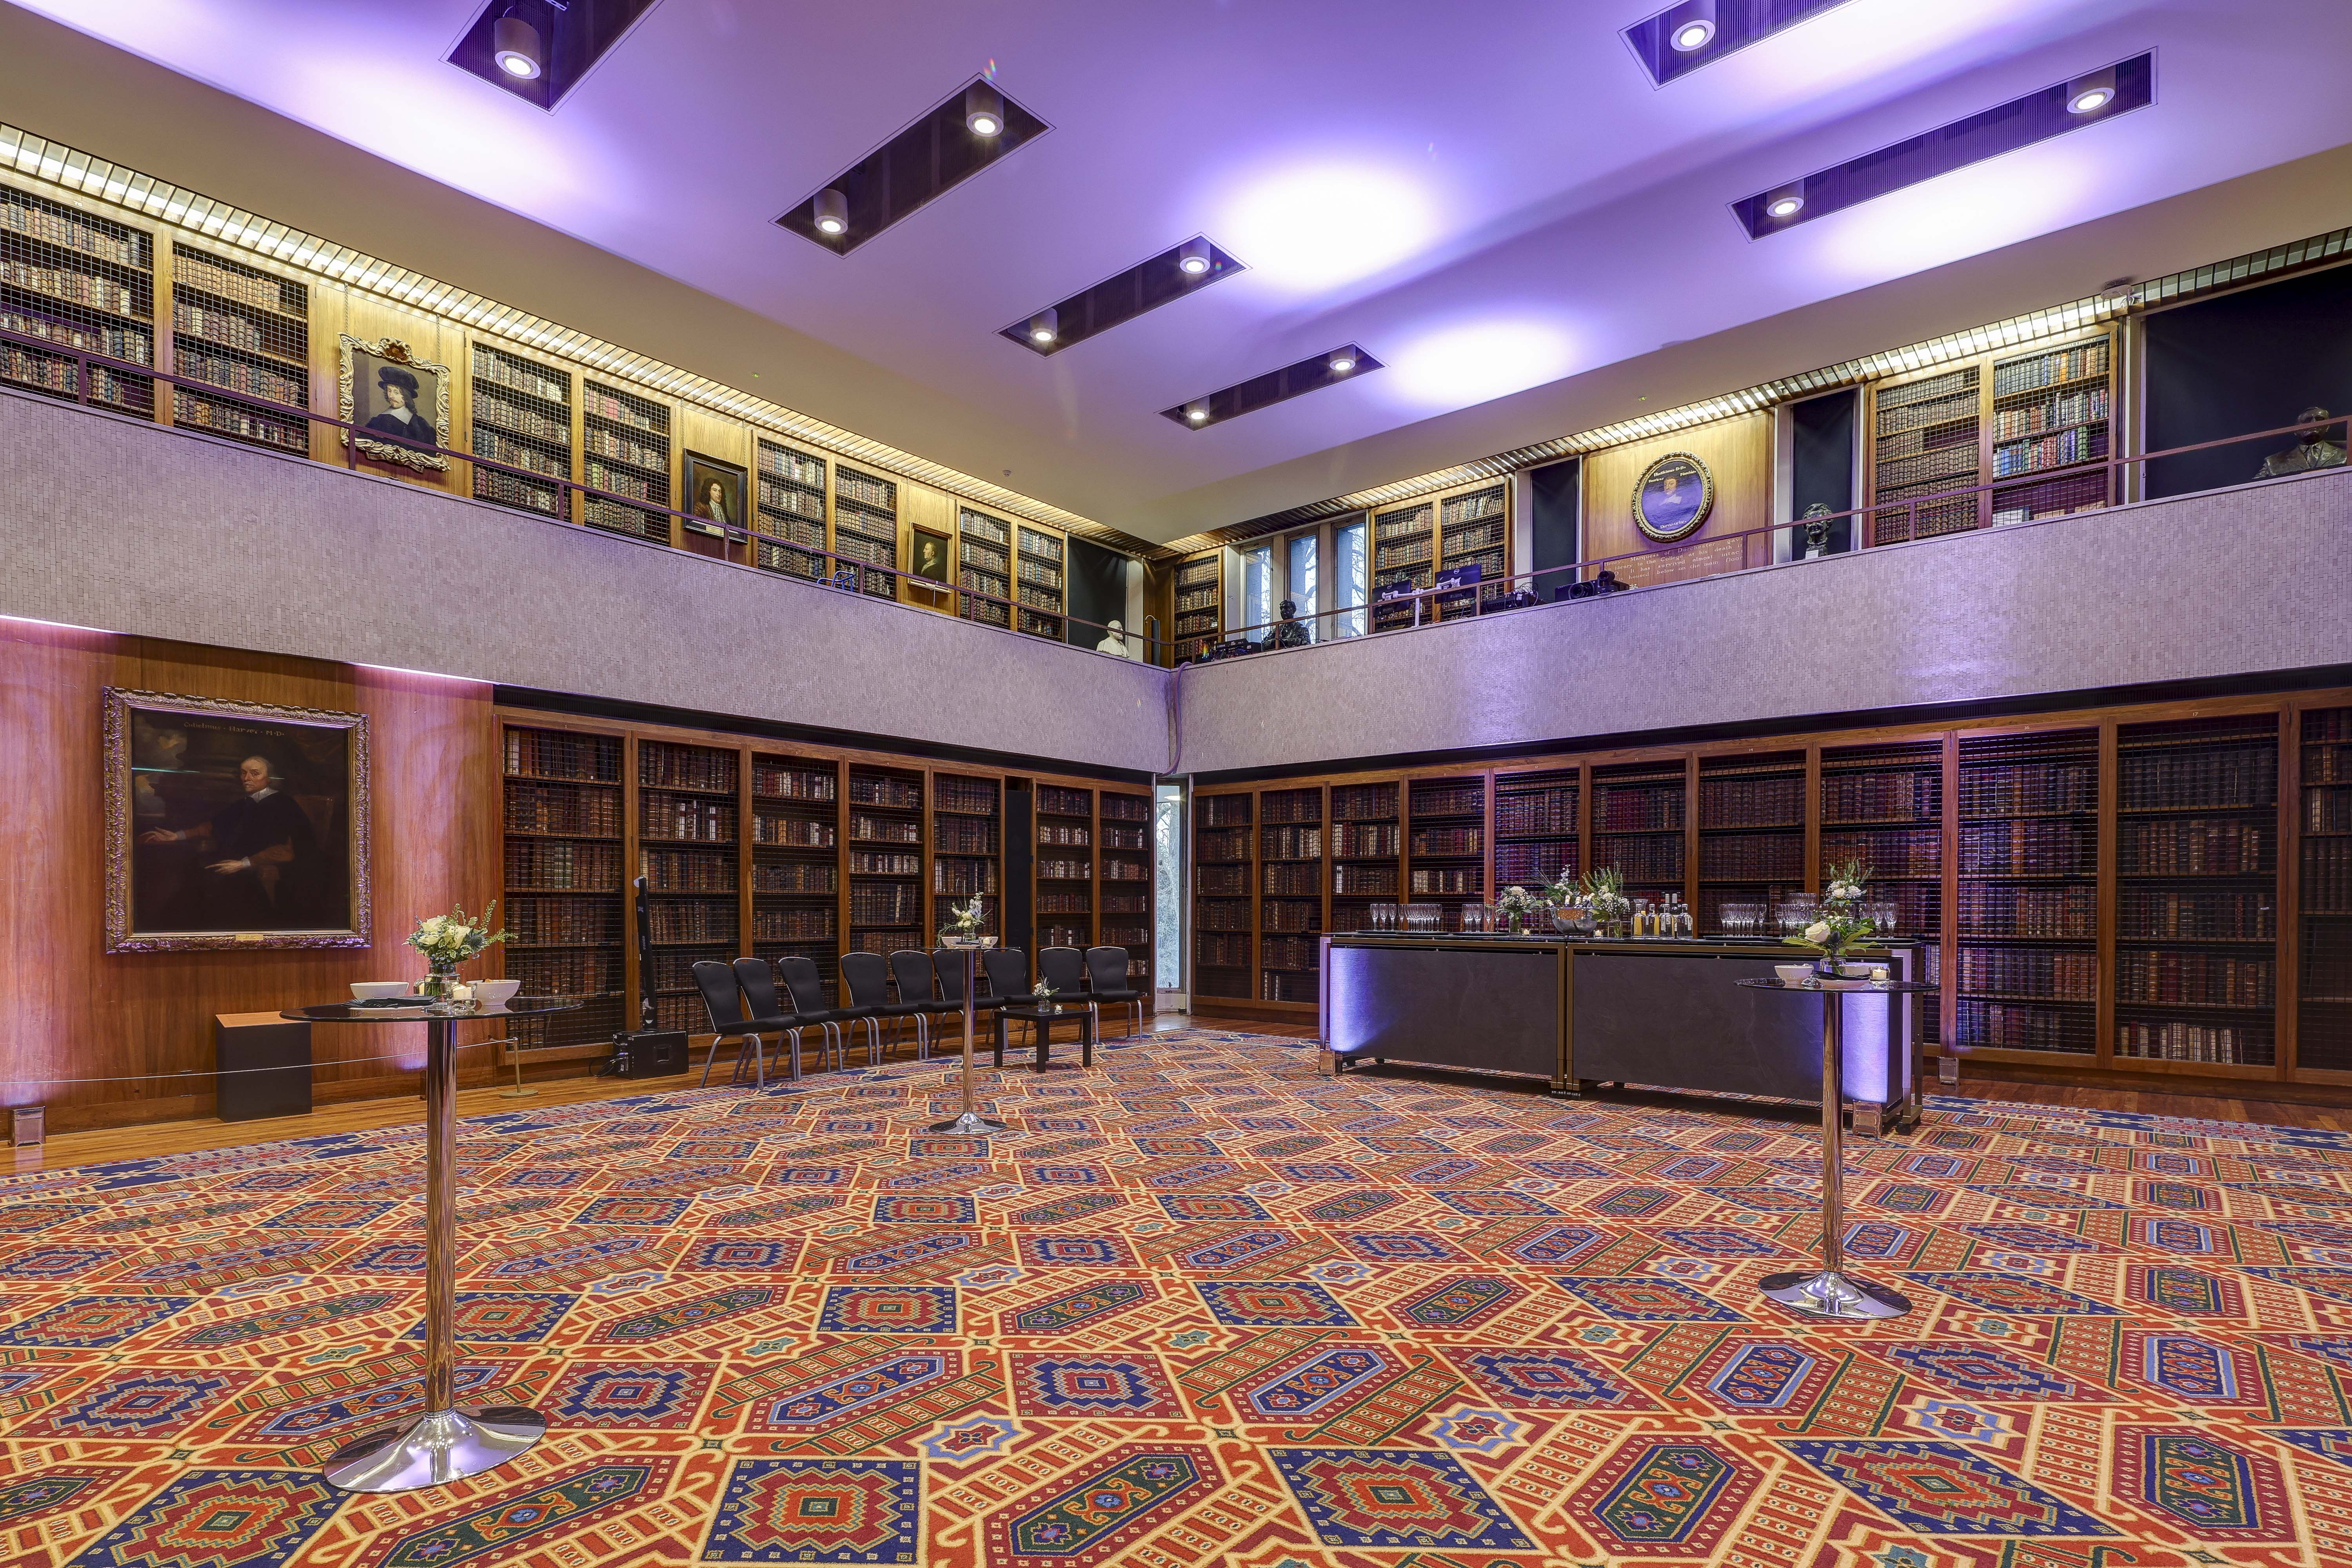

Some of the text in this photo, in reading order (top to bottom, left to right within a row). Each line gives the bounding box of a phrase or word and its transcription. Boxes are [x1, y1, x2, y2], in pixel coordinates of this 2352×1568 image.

[2005, 354, 2026, 362] DONALD
[2027, 349, 2048, 358] HUNTER
[2048, 343, 2075, 352] MEMORIAL
[2075, 338, 2097, 346] LIBRARY
[1631, 553, 1659, 561] Marquess
[1658, 560, 1685, 568] survived
